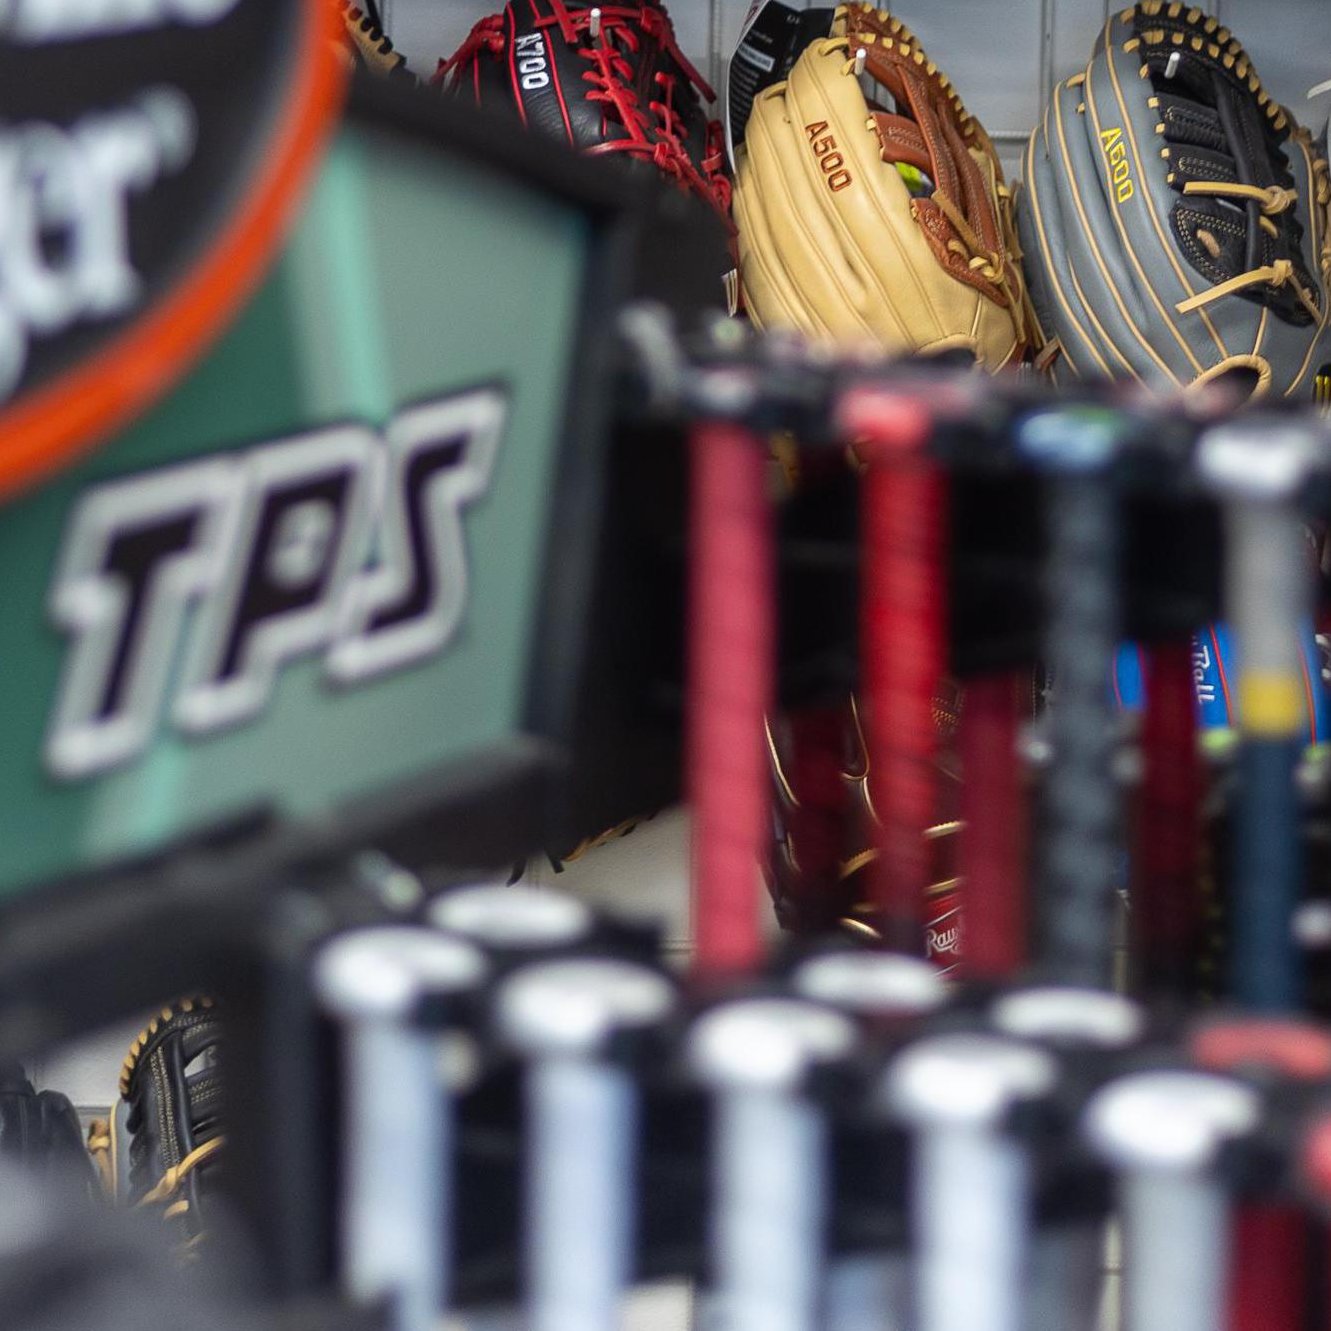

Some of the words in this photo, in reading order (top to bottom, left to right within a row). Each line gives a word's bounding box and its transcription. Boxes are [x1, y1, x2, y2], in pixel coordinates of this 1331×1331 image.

[514, 32, 550, 91] A700
[804, 120, 854, 193] A500
[48, 382, 512, 779] TPS
